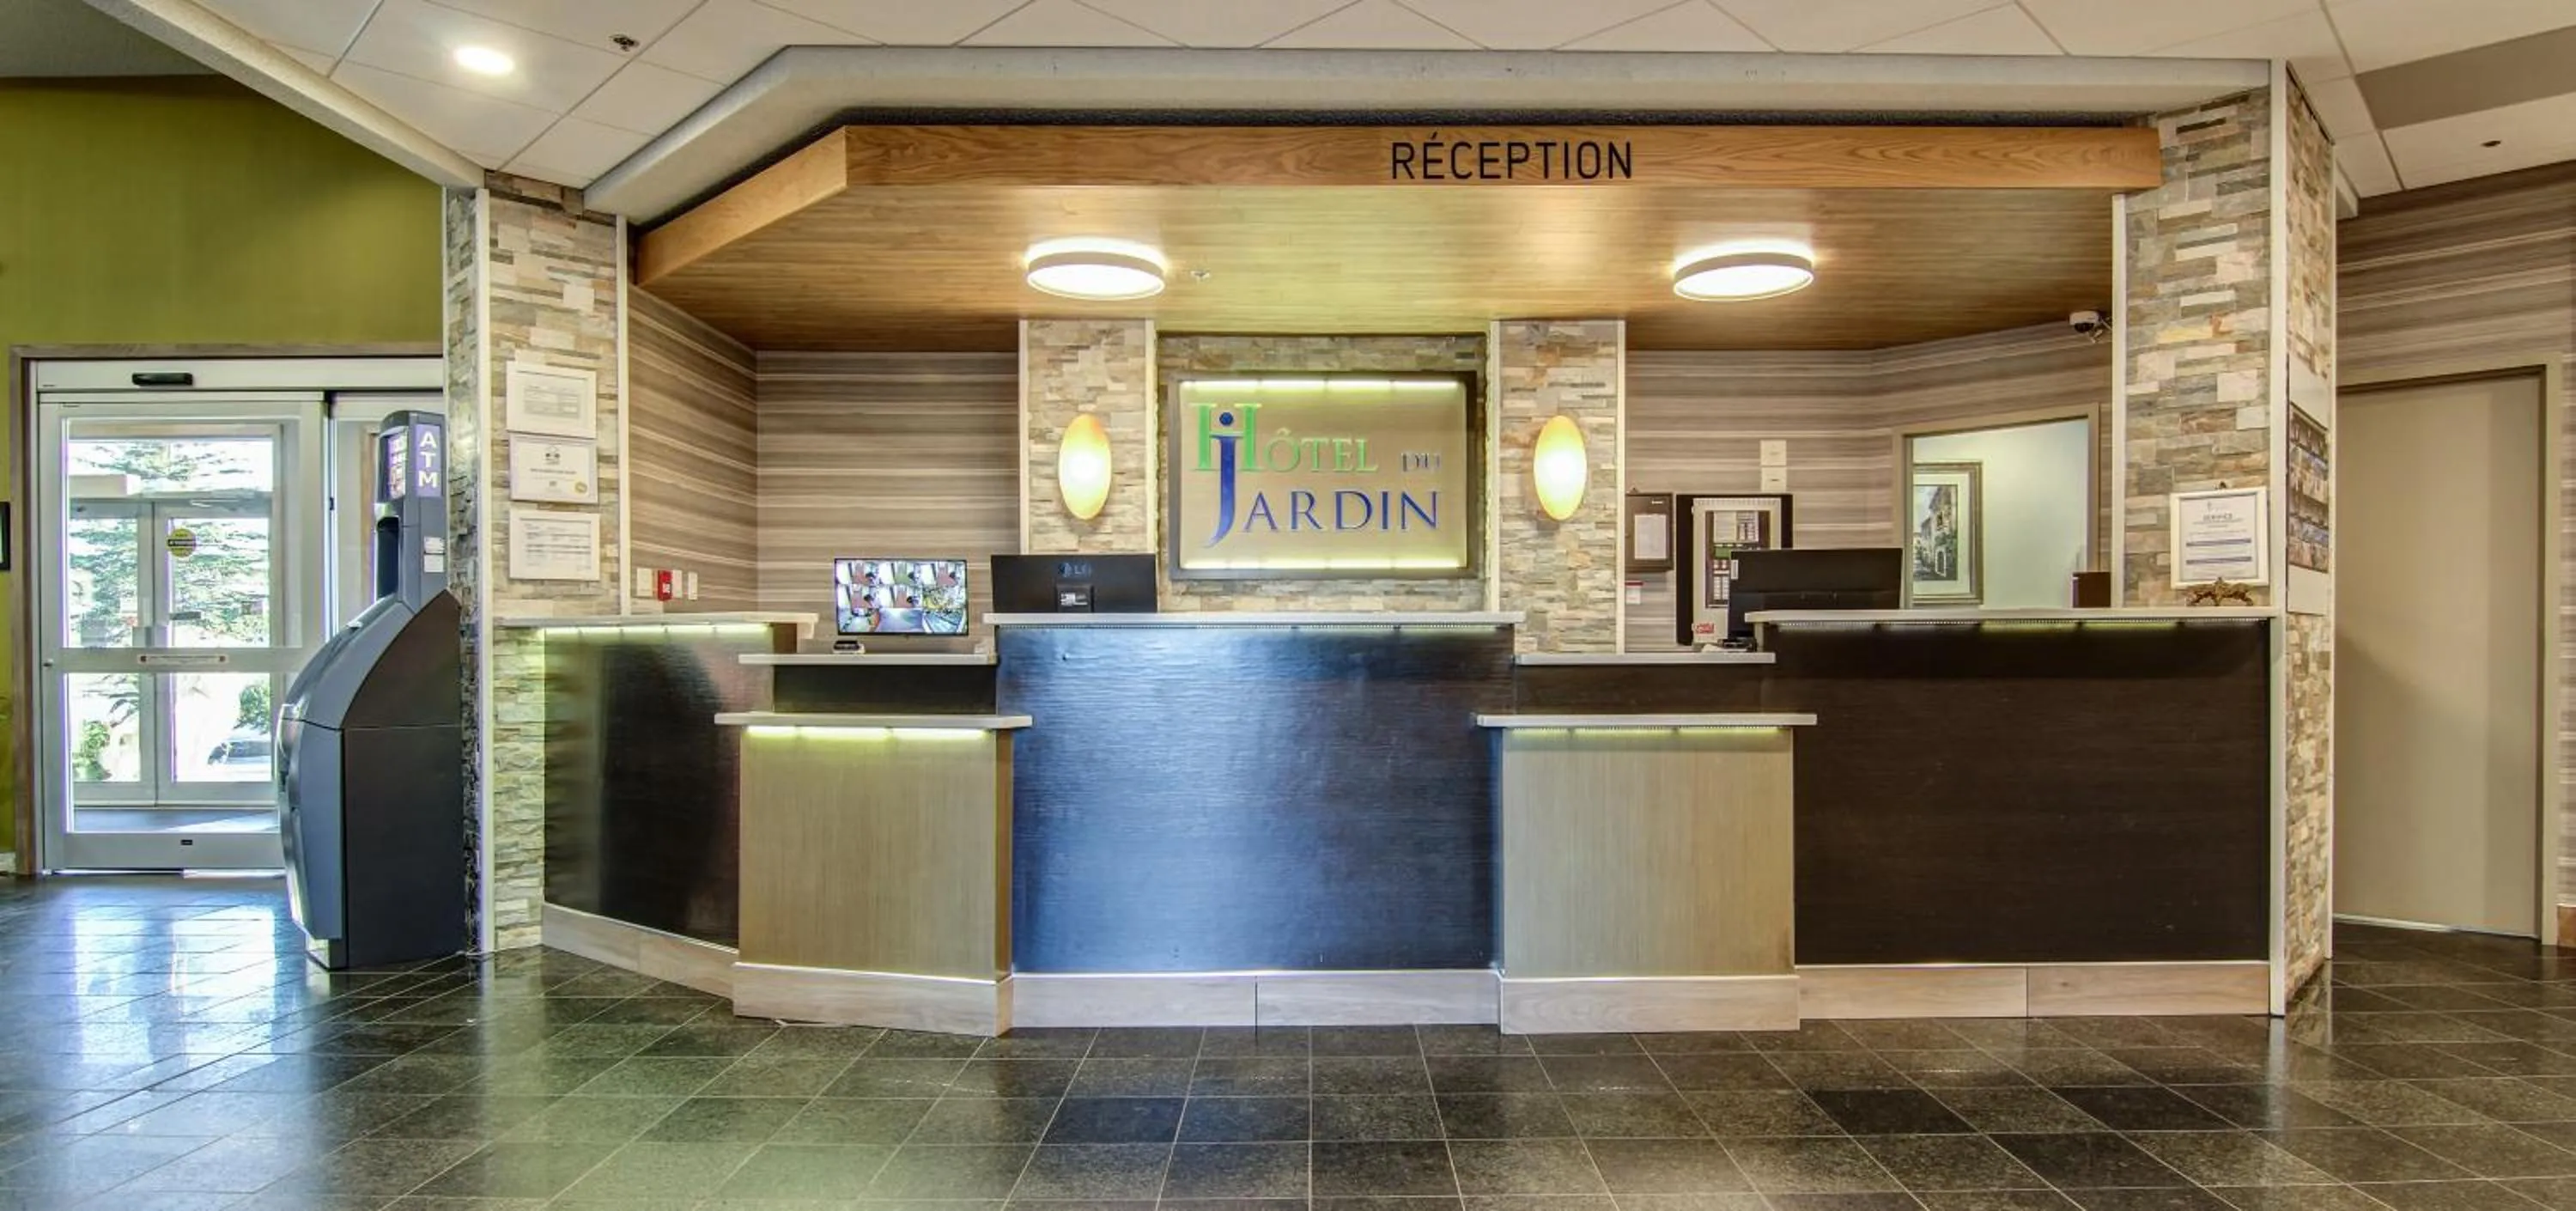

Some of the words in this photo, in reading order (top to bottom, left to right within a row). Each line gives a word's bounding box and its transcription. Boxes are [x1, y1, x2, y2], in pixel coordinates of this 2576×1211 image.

[1392, 131, 1632, 180] RÉCEPTION
[418, 430, 438, 489] ATM
[1189, 403, 1379, 473] HÔTEL
[1400, 452, 1441, 472] DU
[1204, 412, 1440, 548] JARDIN
